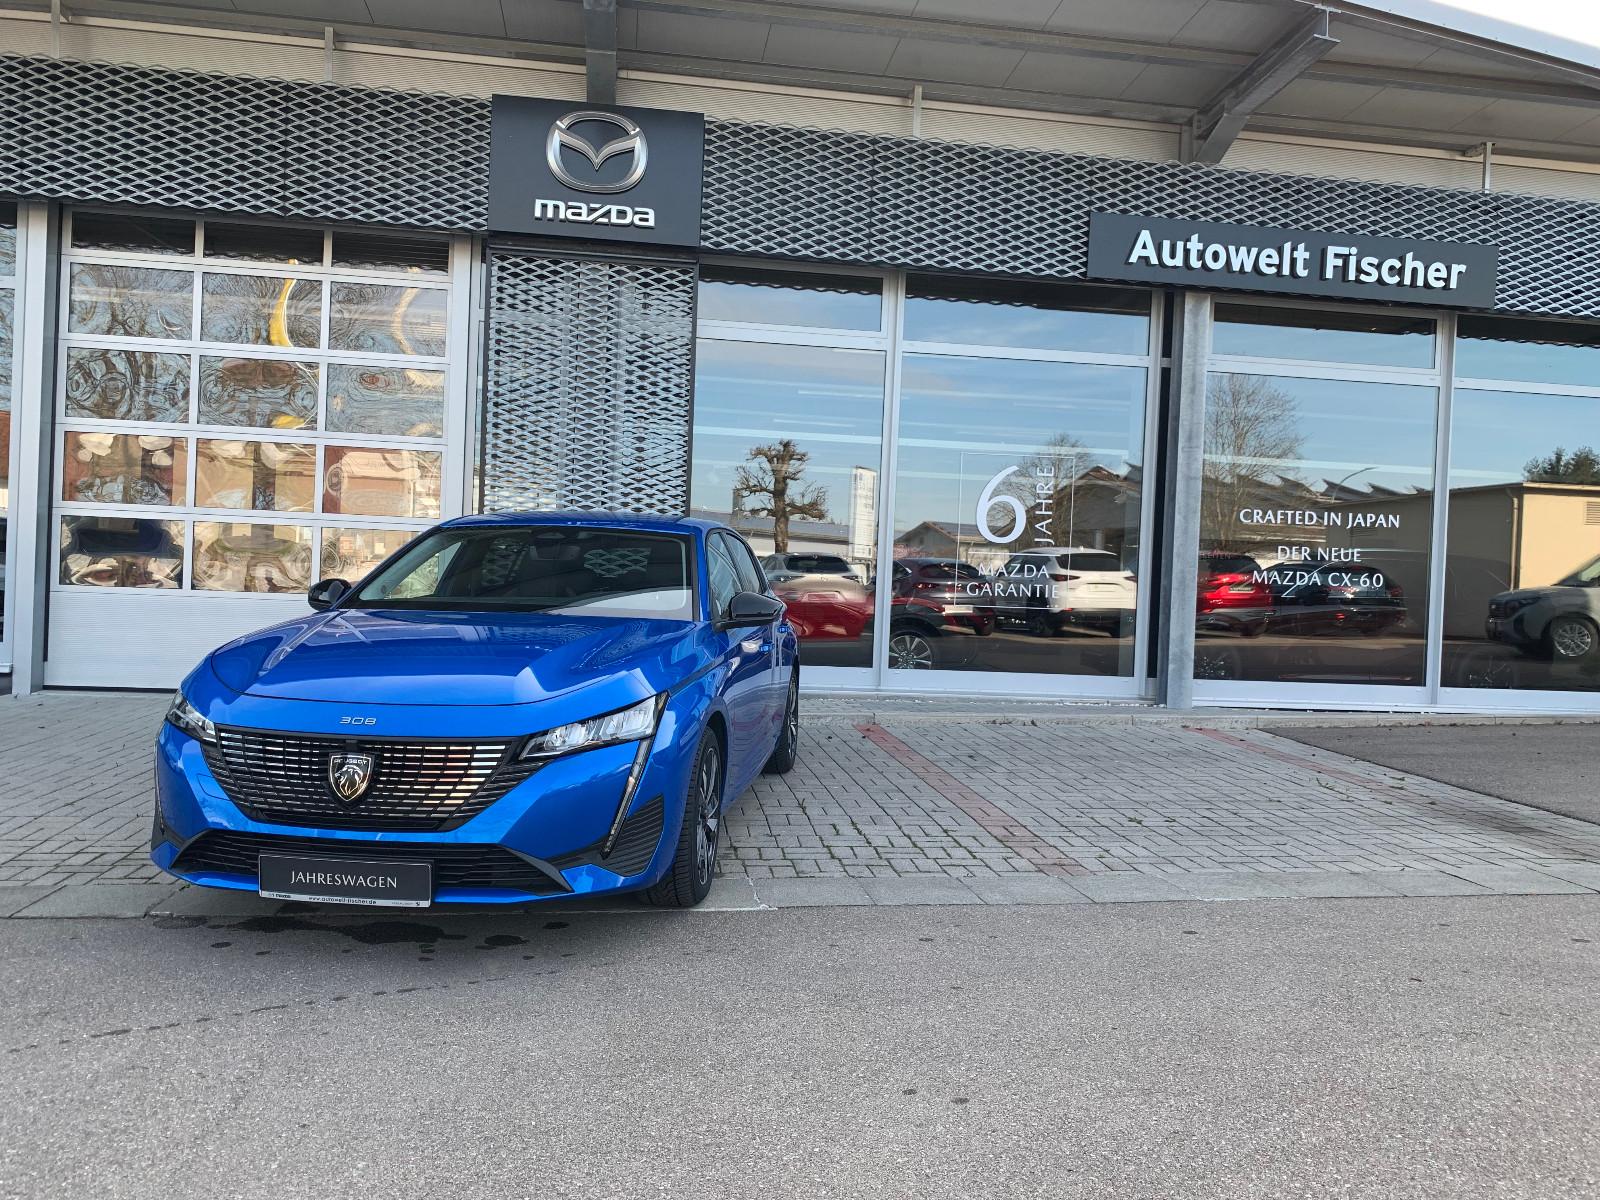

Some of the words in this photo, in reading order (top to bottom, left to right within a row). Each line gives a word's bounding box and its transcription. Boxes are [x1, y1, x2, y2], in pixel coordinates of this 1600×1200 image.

[534, 198, 656, 228] mazda
[1127, 229, 1310, 278] Autowelt
[1324, 245, 1467, 289] Fischer
[976, 465, 1027, 544] 6
[1034, 466, 1055, 546] JAHRE
[1239, 508, 1317, 526] CRAFTED
[1323, 511, 1342, 527] IN
[1346, 512, 1401, 529] JAPAN
[1277, 545, 1311, 561] DER
[1317, 547, 1362, 562] NEUE
[978, 563, 1050, 579] MAZDA
[1252, 570, 1321, 586] MAZDA
[1327, 572, 1384, 587] CX-60
[966, 582, 1060, 599] GARANTIE
[339, 716, 377, 725] 308
[290, 870, 398, 889] JAHRESWAGEN
